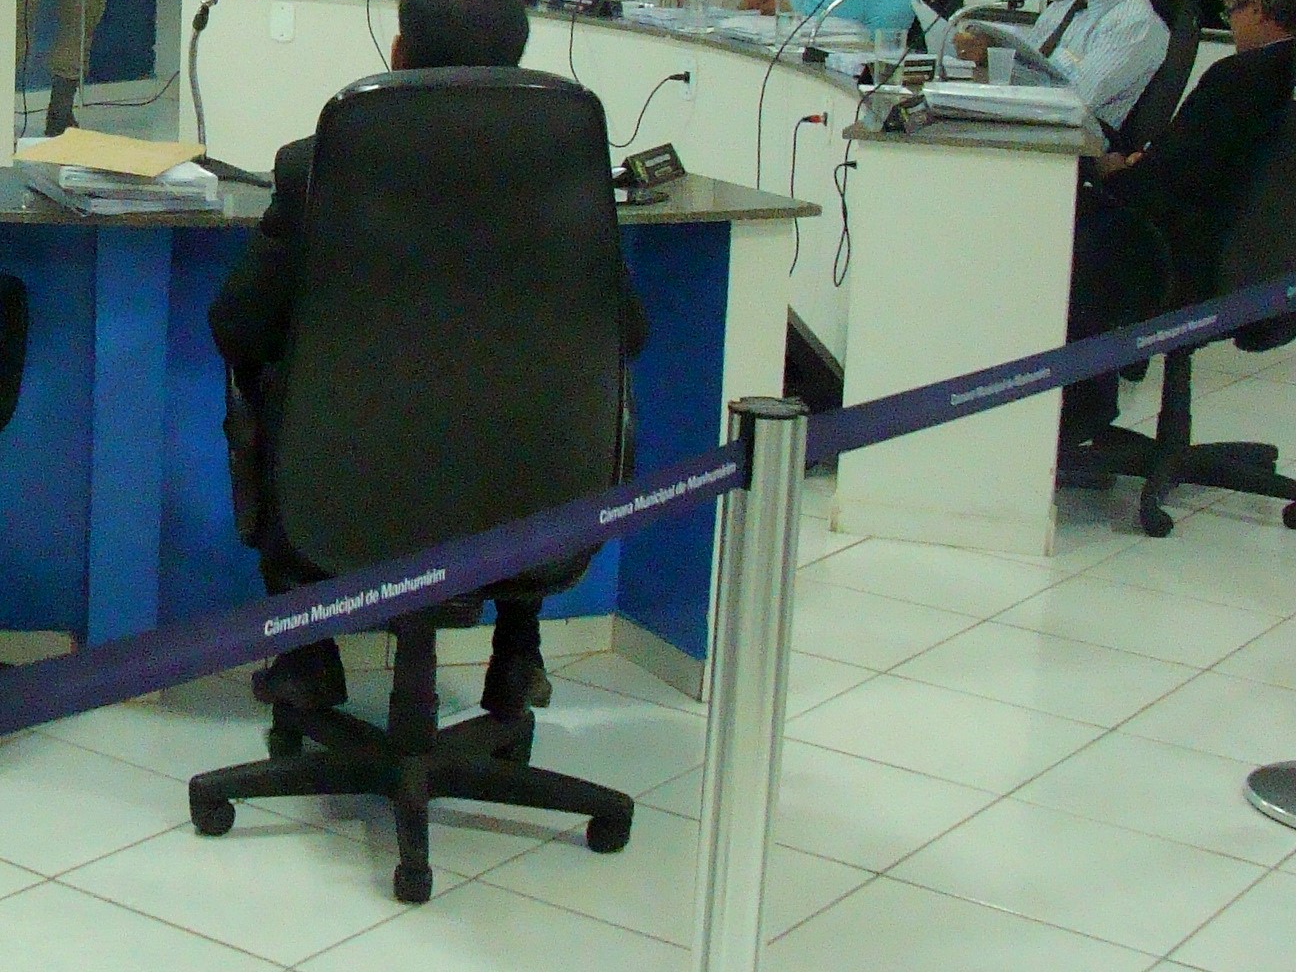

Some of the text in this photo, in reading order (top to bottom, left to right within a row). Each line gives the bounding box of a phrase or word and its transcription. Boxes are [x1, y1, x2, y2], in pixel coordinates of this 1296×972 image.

[264, 568, 446, 637] Câmara Municipal de Manhumirim
